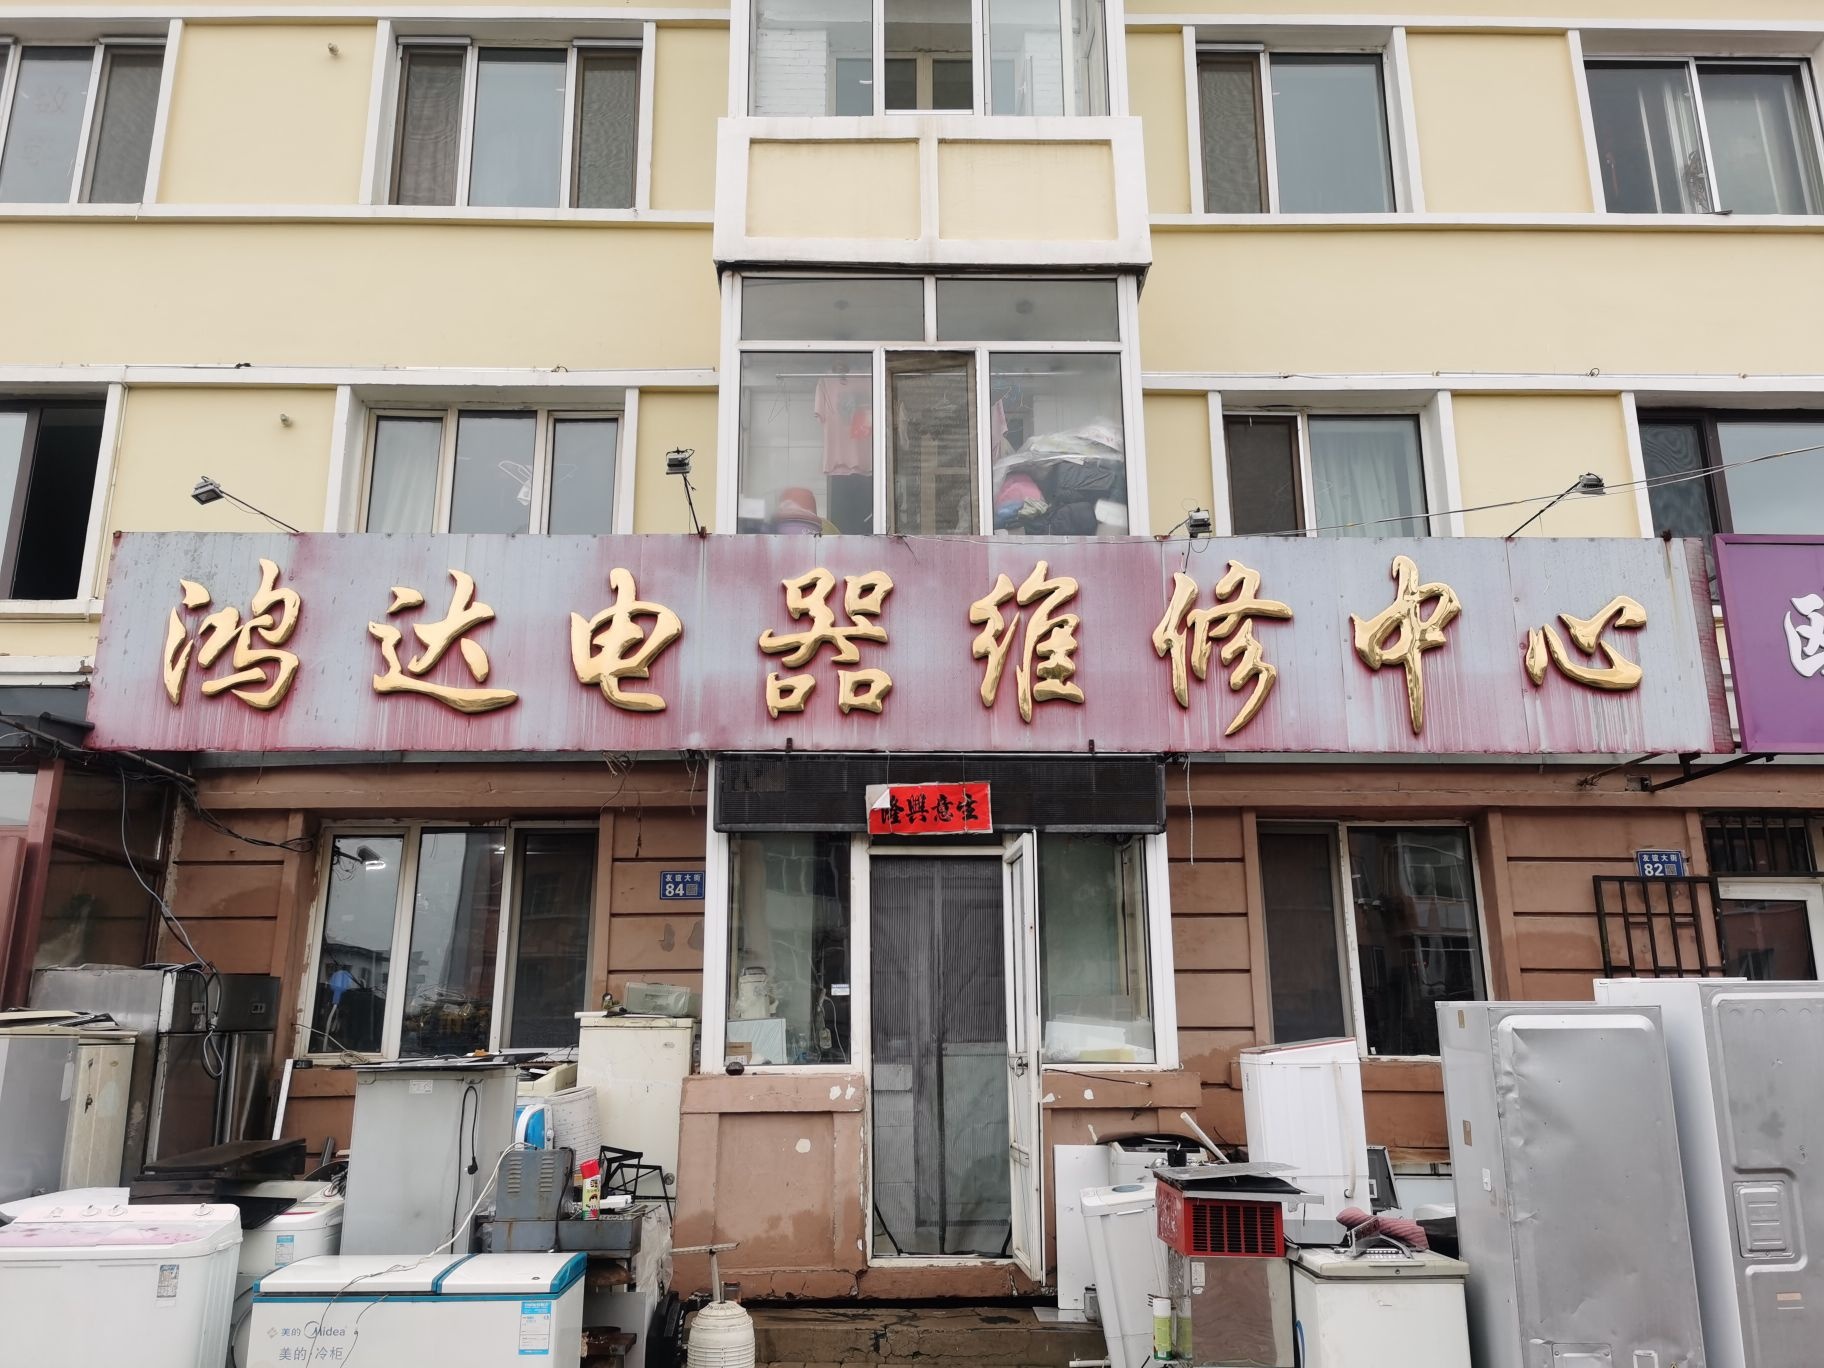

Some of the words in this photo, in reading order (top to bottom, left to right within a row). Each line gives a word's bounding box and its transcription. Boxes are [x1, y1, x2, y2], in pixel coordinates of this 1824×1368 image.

[162, 557, 1646, 738] 鸿达电器维修中心
[1644, 863, 1664, 876] 82
[665, 883, 685, 896] 84
[281, 1327, 301, 1337] 美的
[310, 1325, 346, 1337] Midea
